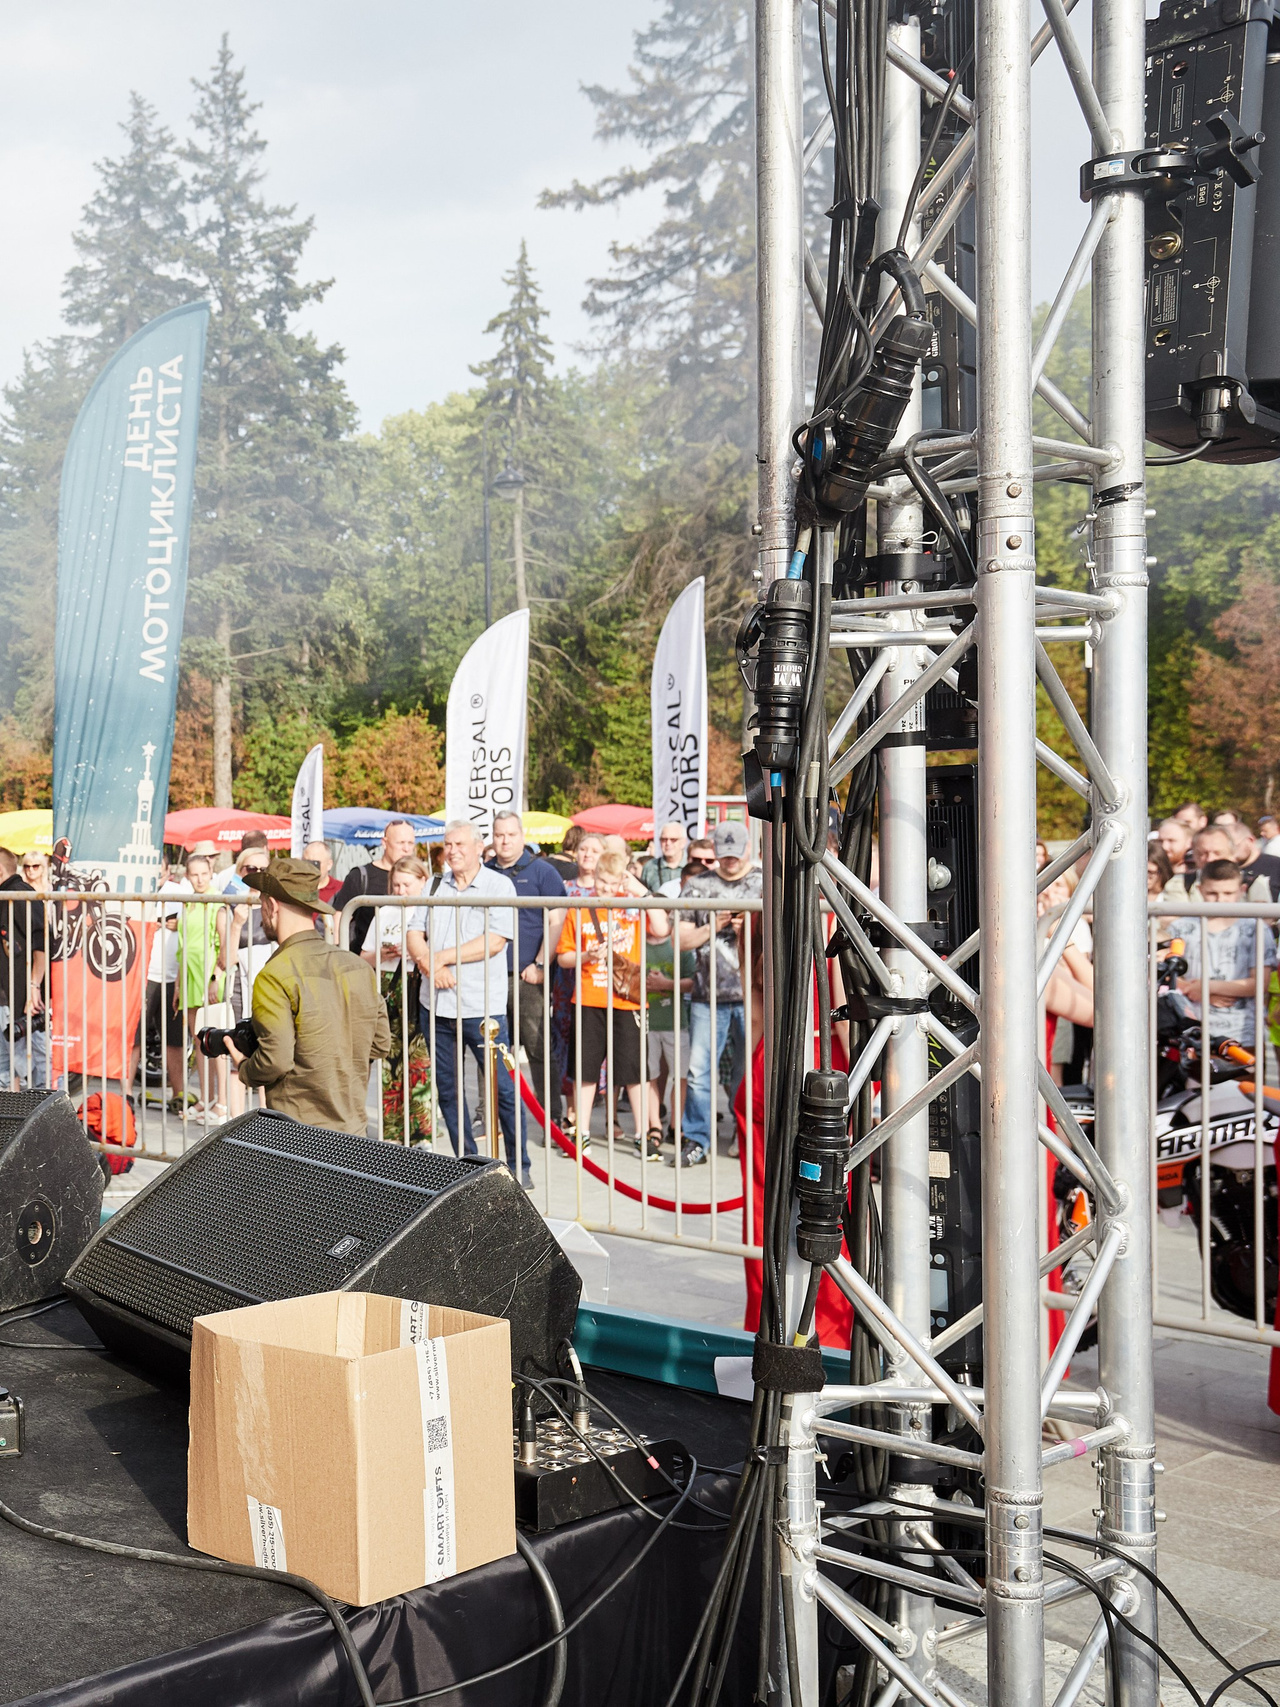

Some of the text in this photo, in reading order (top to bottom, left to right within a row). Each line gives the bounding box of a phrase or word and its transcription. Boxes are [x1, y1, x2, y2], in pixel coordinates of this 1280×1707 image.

[124, 366, 153, 471] ДЕНЬ
[138, 354, 184, 684] МОТОЦИКЛИСТА
[773, 672, 802, 686] WM
[774, 664, 802, 673] GROUP
[435, 1466, 445, 1509] GIFTS
[265, 1506, 274, 1529] (495)
